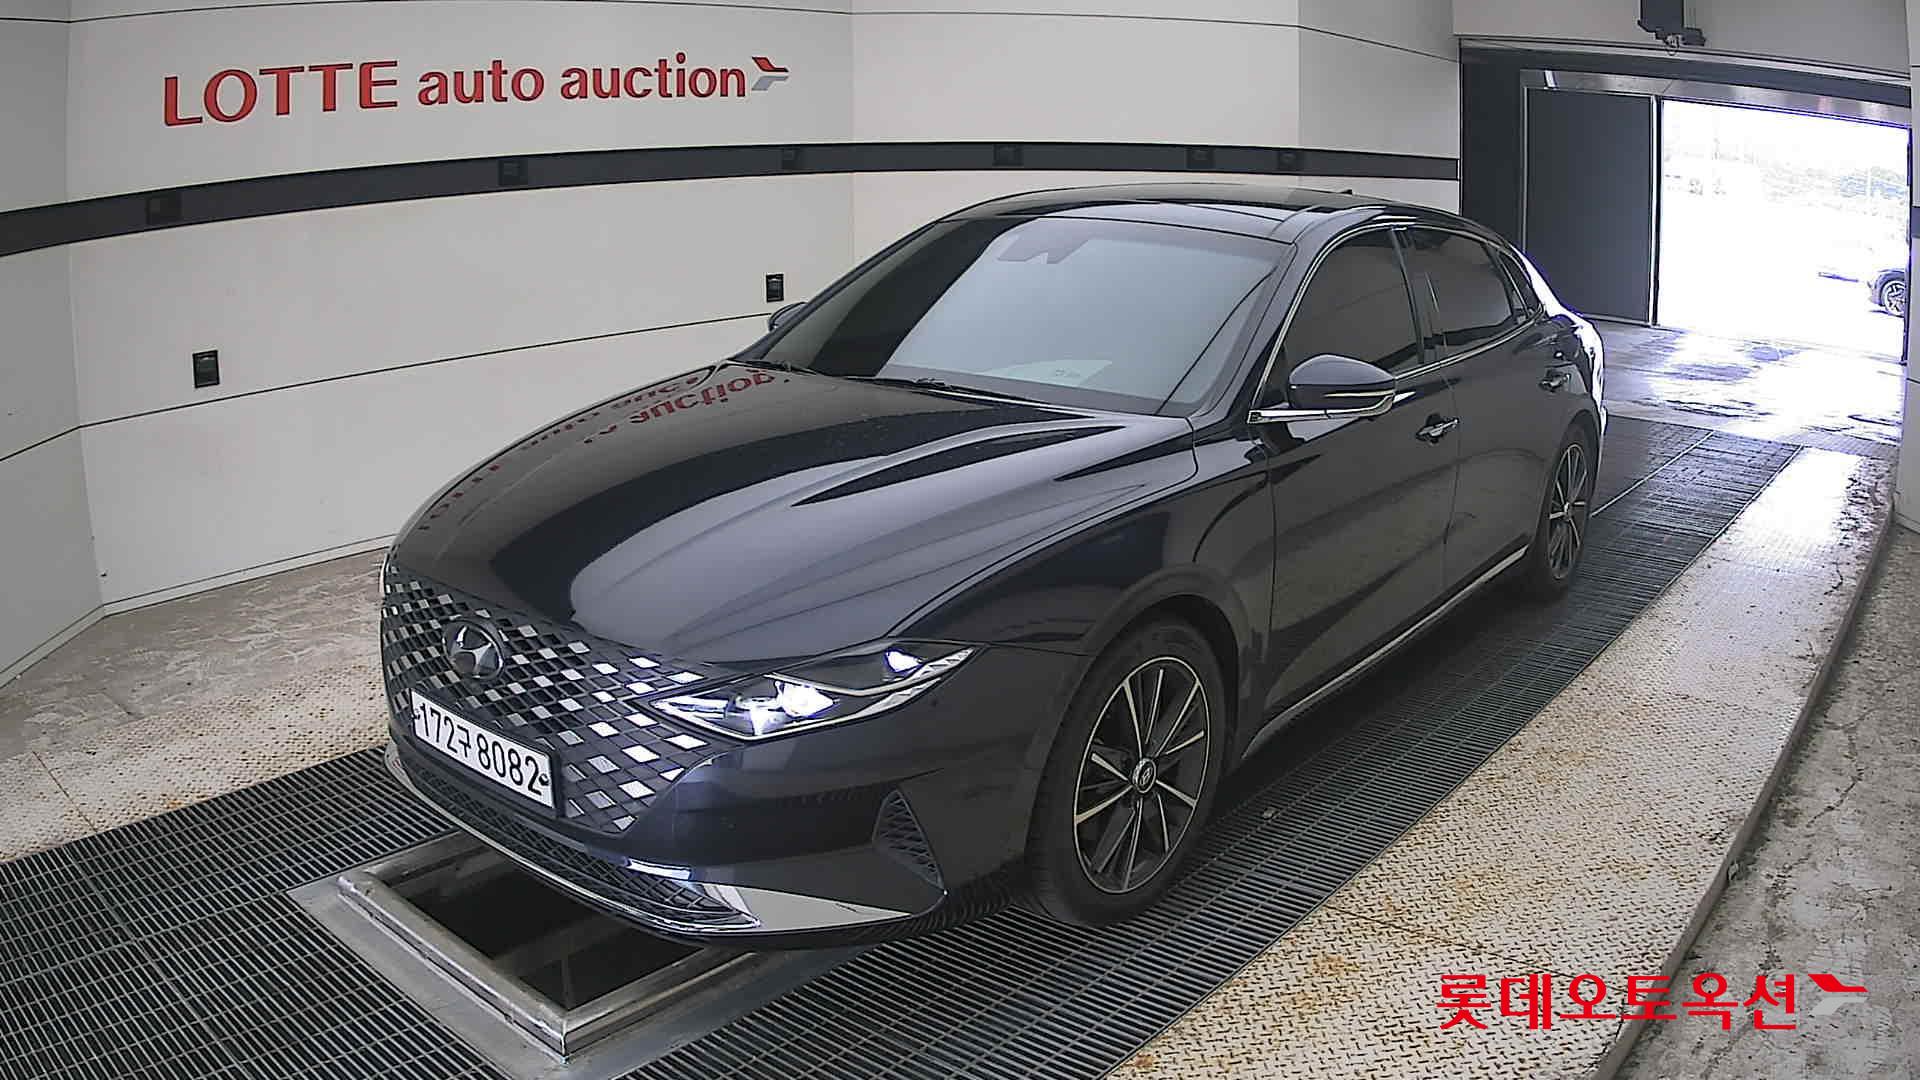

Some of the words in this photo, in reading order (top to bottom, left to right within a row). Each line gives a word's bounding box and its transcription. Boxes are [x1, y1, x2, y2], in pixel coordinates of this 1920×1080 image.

[163, 60, 399, 127] LOTTE
[417, 58, 546, 106] auto
[560, 52, 747, 101] auction
[477, 733, 542, 796] 8082
